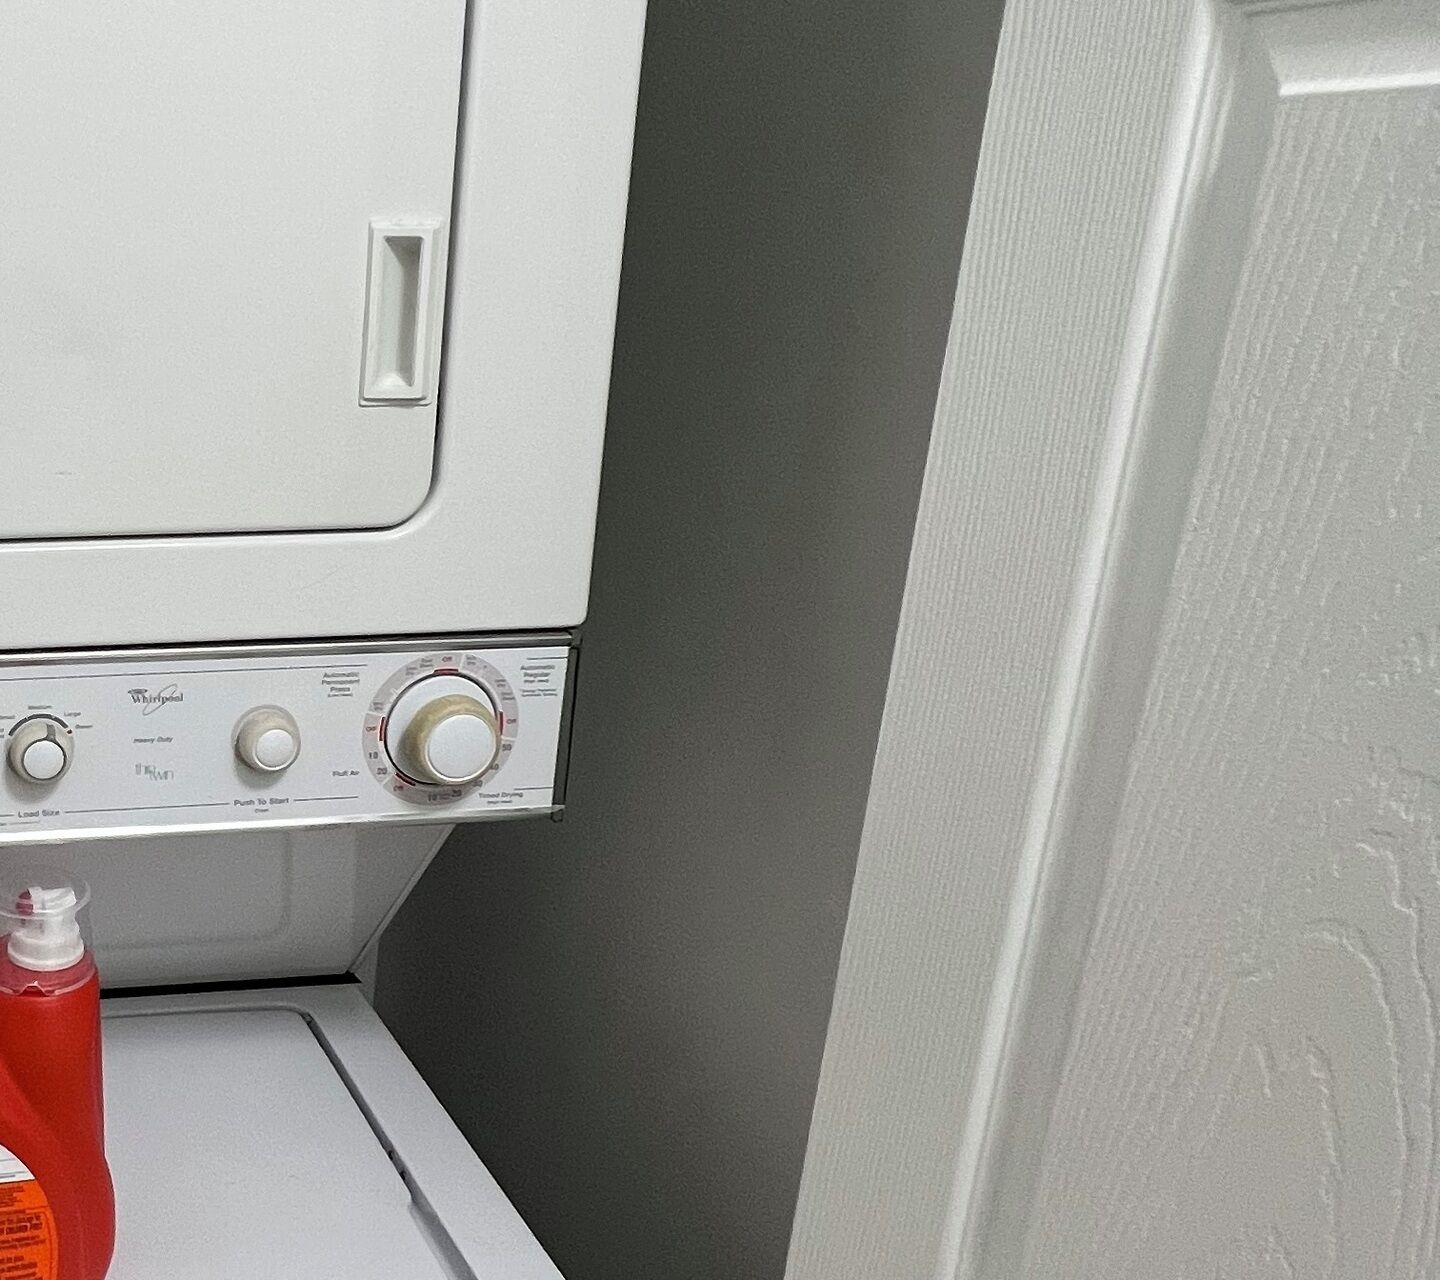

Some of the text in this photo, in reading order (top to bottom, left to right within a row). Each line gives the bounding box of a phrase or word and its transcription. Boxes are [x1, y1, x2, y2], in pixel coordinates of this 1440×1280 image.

[130, 690, 184, 706] Whirlpool
[257, 798, 267, 806] To
[269, 797, 289, 805] Start
[18, 809, 60, 818] Load Size
